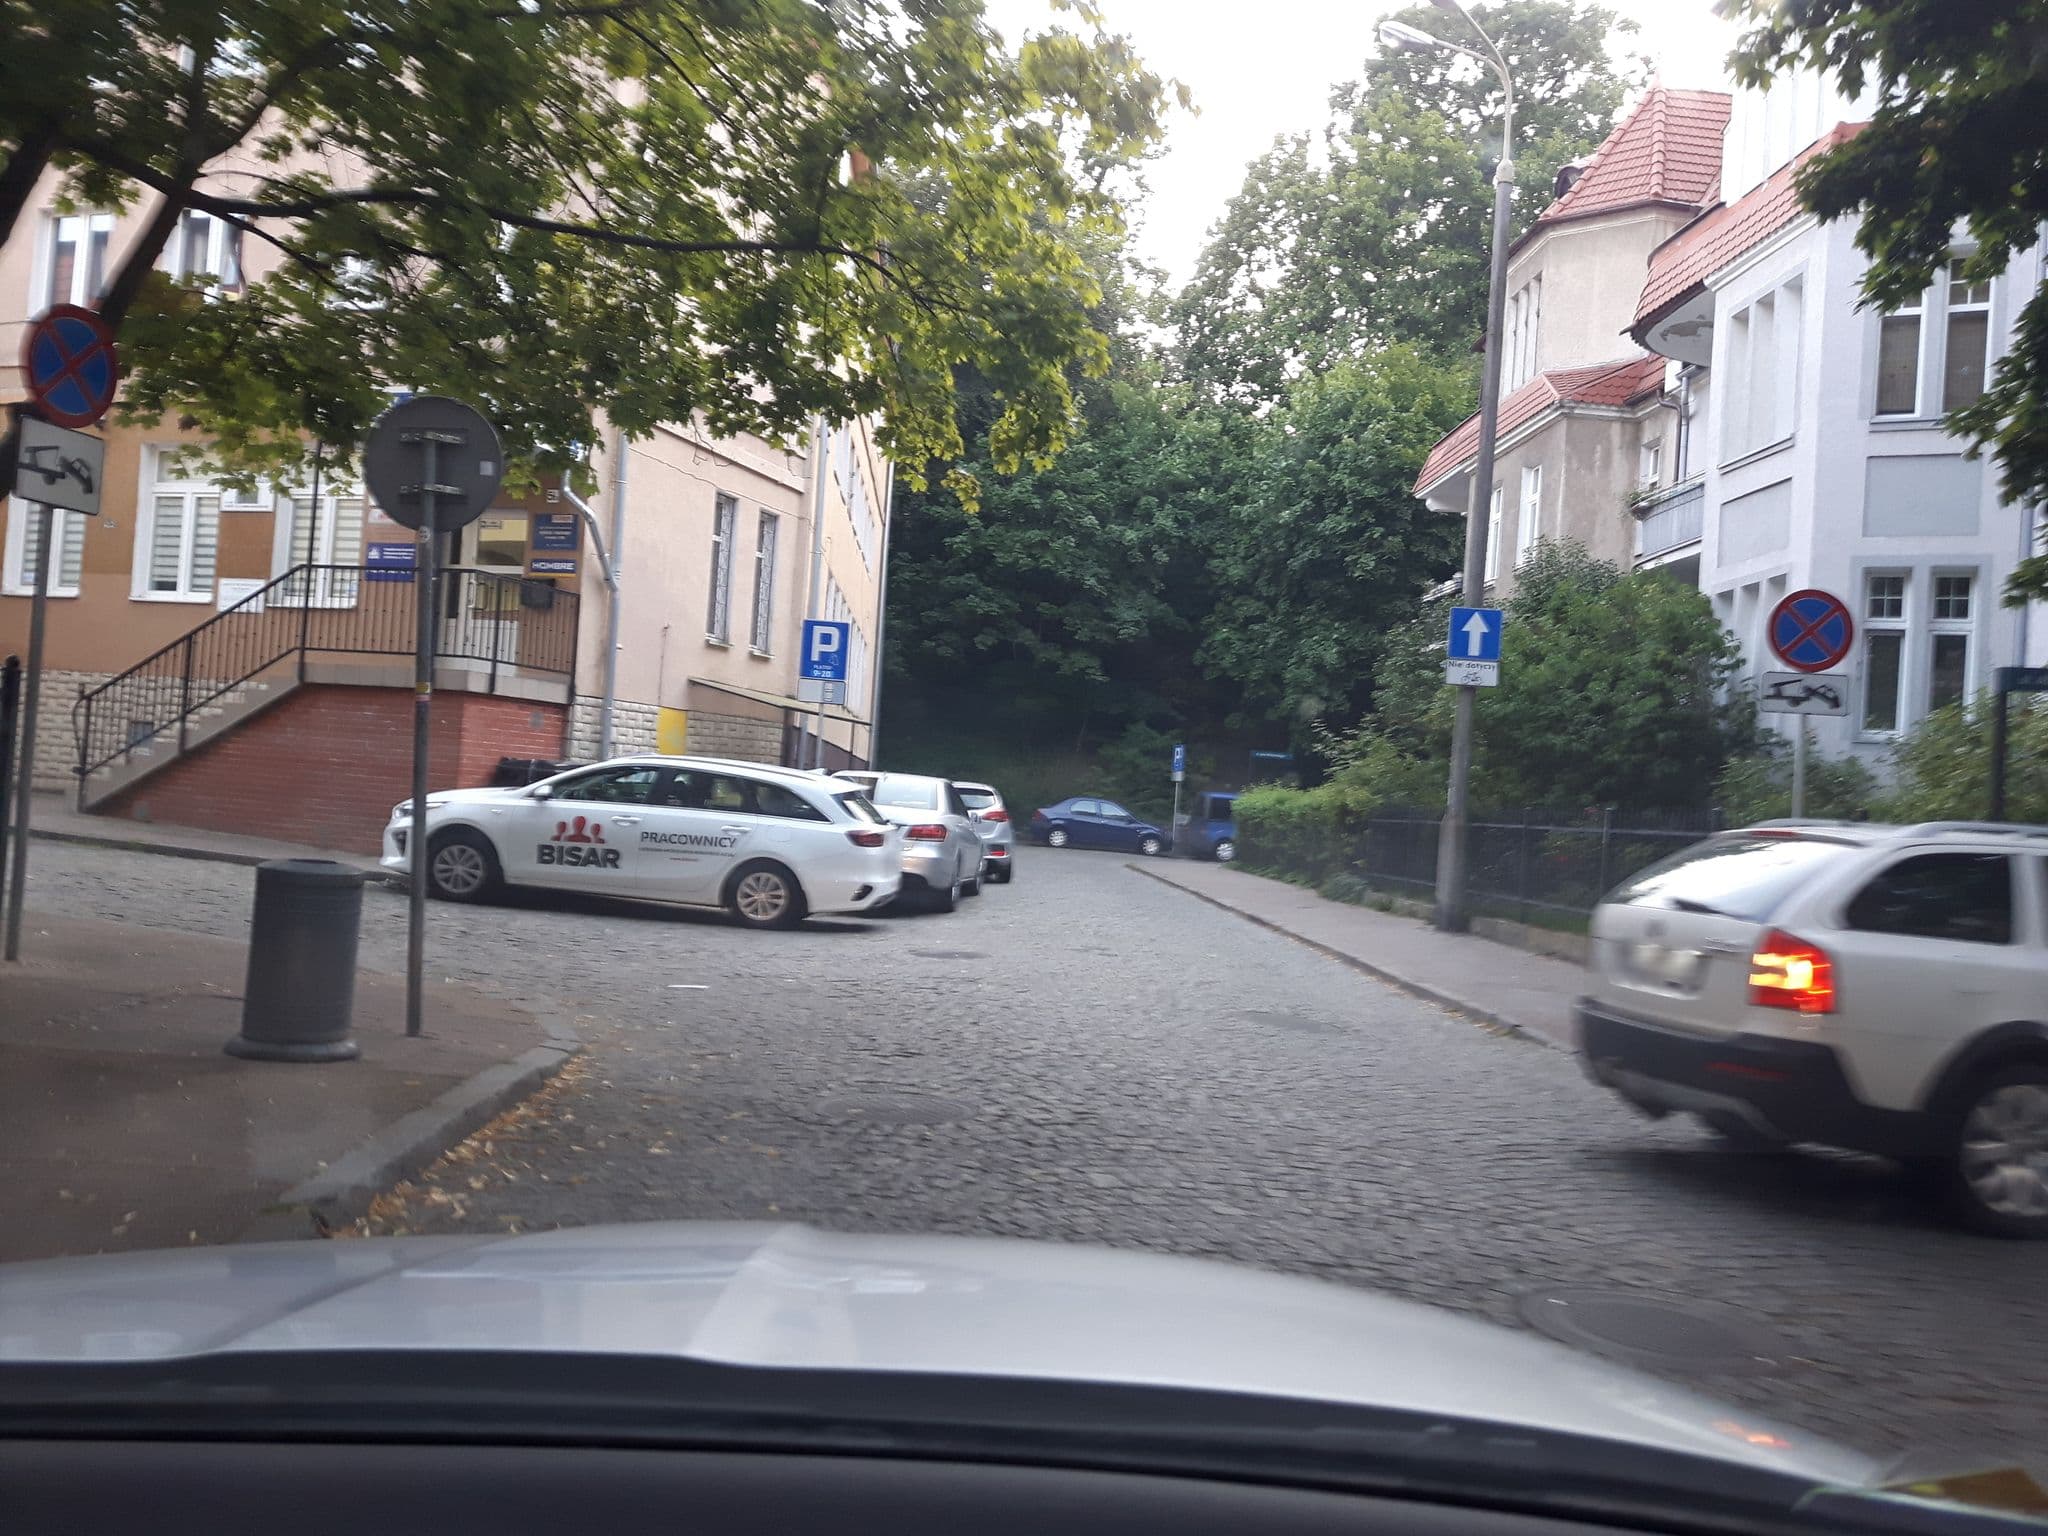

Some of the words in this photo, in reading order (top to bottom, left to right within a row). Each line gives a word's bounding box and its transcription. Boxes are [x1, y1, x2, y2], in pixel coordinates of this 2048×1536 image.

[810, 625, 840, 661] P
[813, 669, 831, 678] 9-20
[1466, 662, 1496, 671] dotyczy
[640, 831, 737, 848] PRACOWNICY
[537, 843, 621, 869] BISAR
